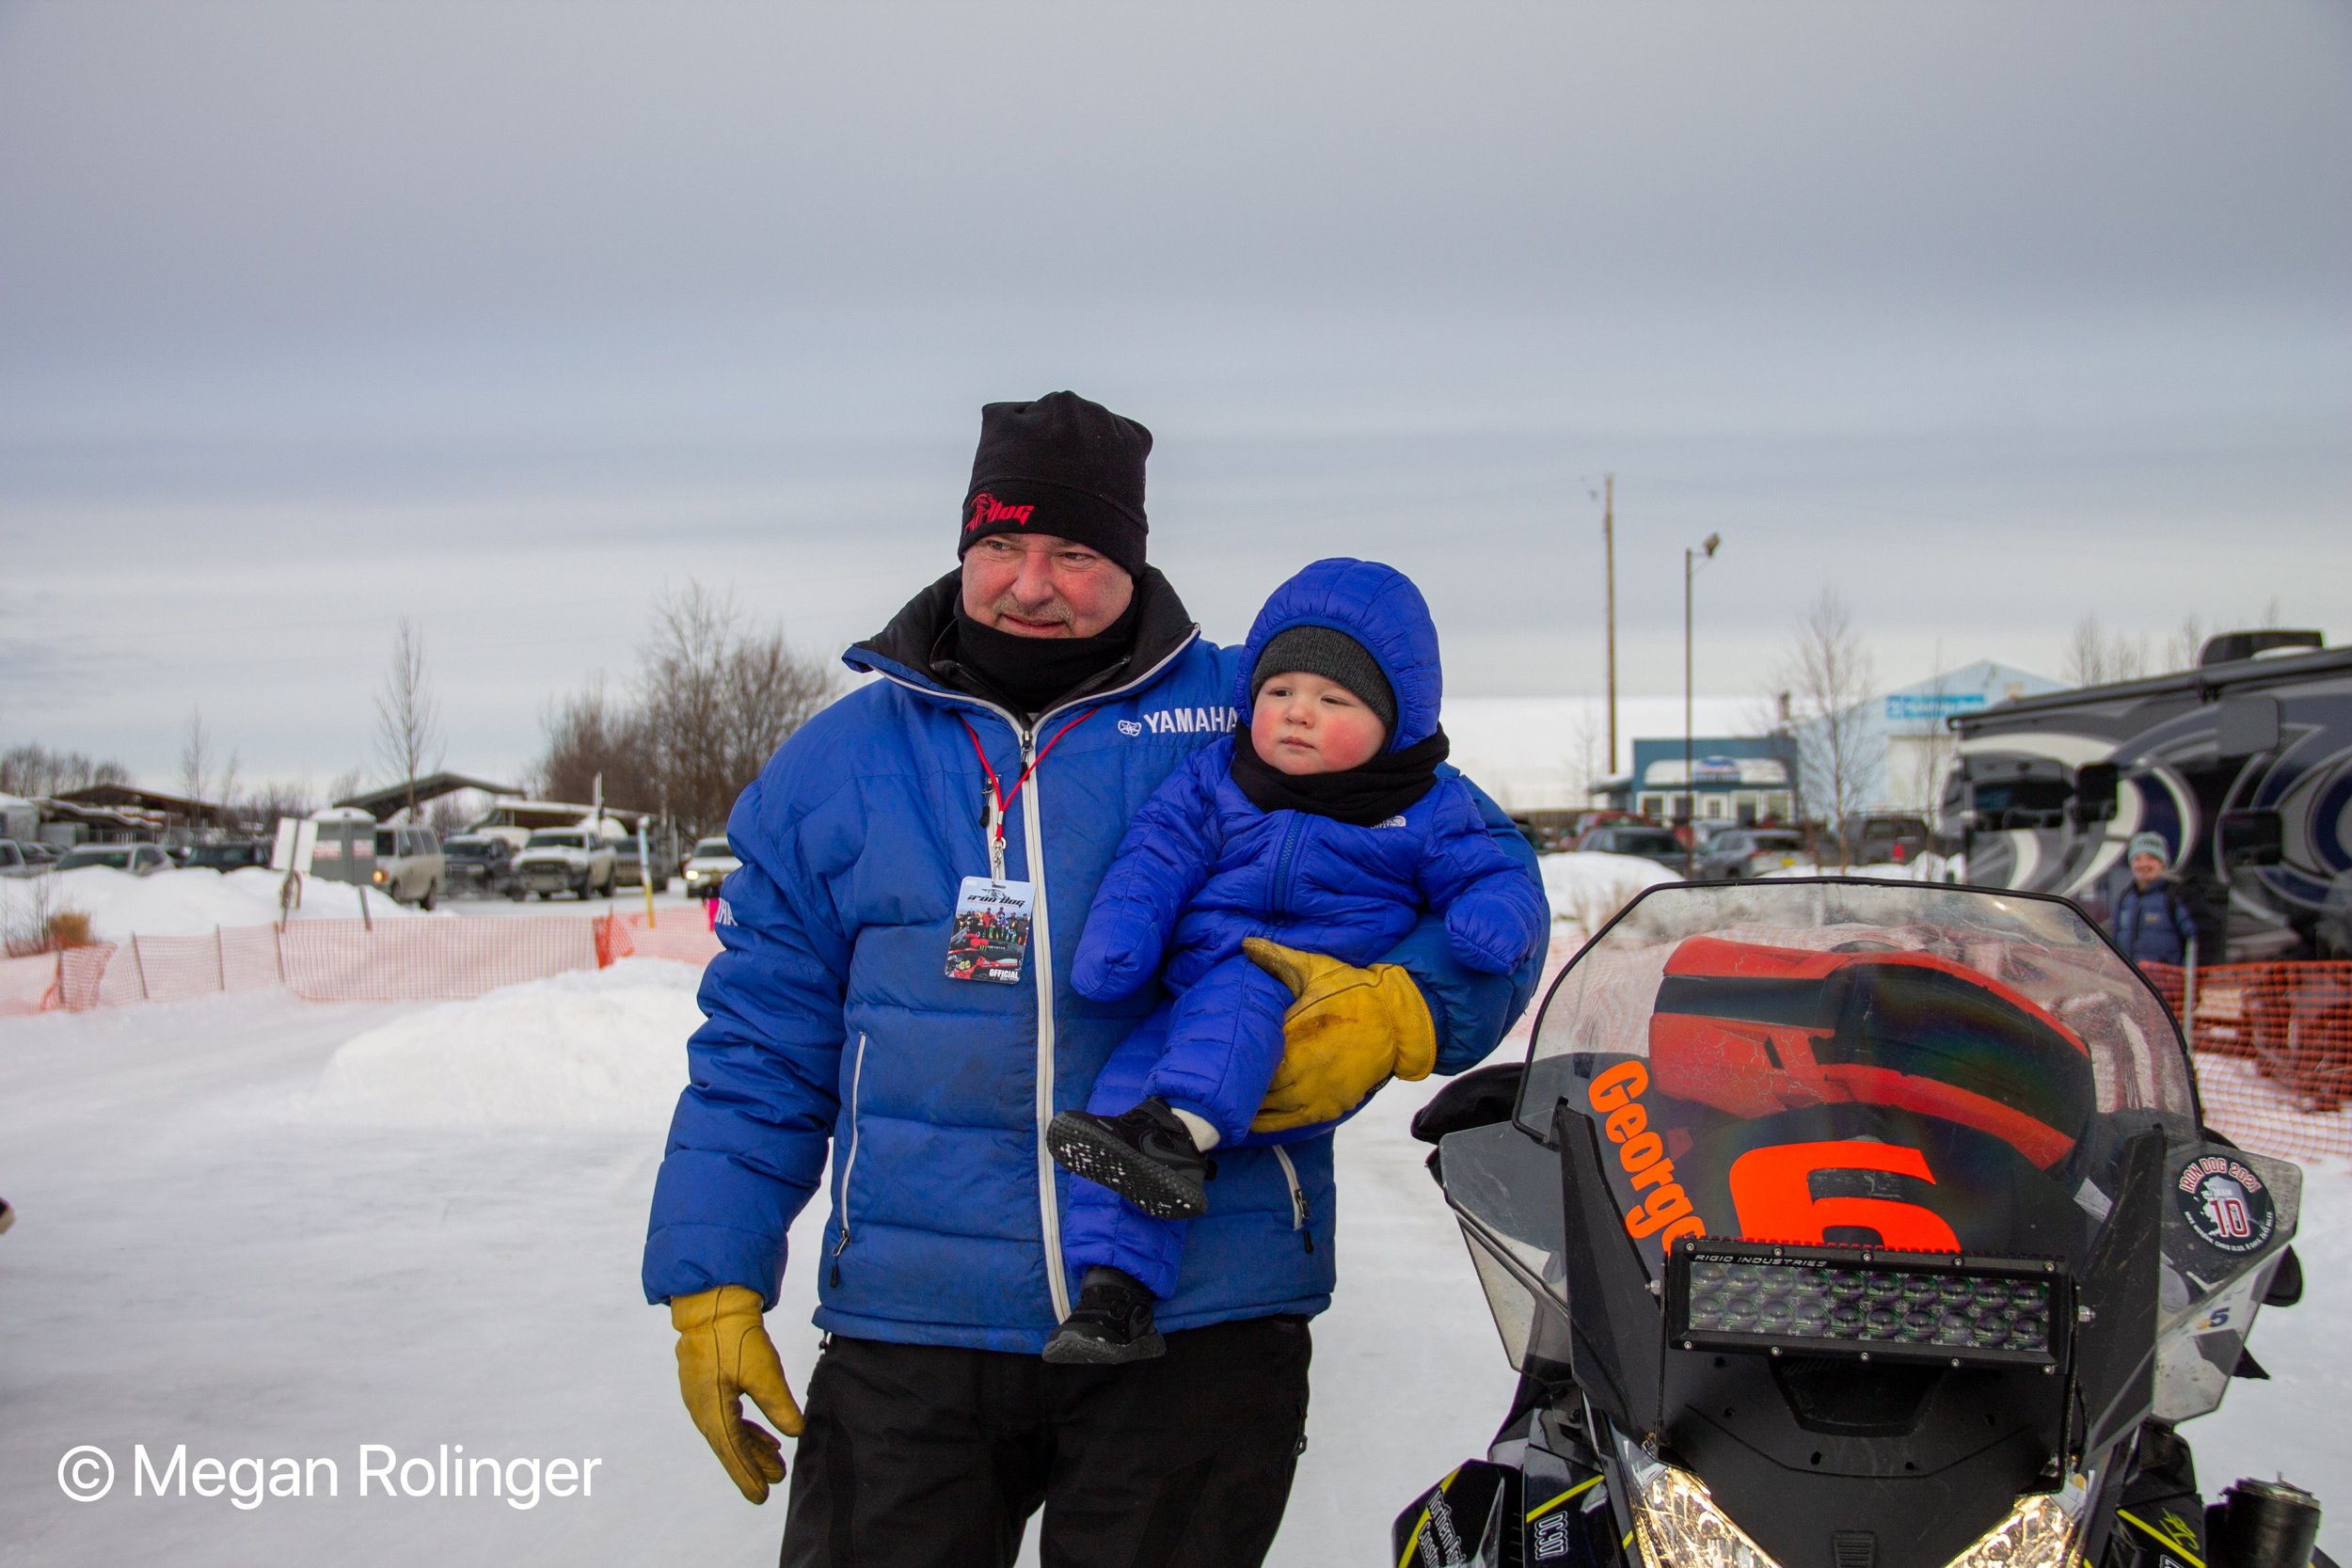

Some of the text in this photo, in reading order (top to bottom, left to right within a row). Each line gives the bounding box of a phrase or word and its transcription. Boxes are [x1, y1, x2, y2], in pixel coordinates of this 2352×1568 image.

[1143, 706, 1239, 734] YAMAHA
[989, 969, 1019, 978] OFFICIAL
[2179, 1157, 2263, 1194] IRON DOG 2021
[1729, 1140, 1962, 1254] 6
[2210, 1197, 2252, 1238] 10
[1694, 1254, 1828, 1268] RIGID INDUSTRIES
[2209, 1306, 2230, 1327] 5
[1427, 1489, 1454, 1549] Northern
[1538, 1513, 1564, 1557] DC 907
